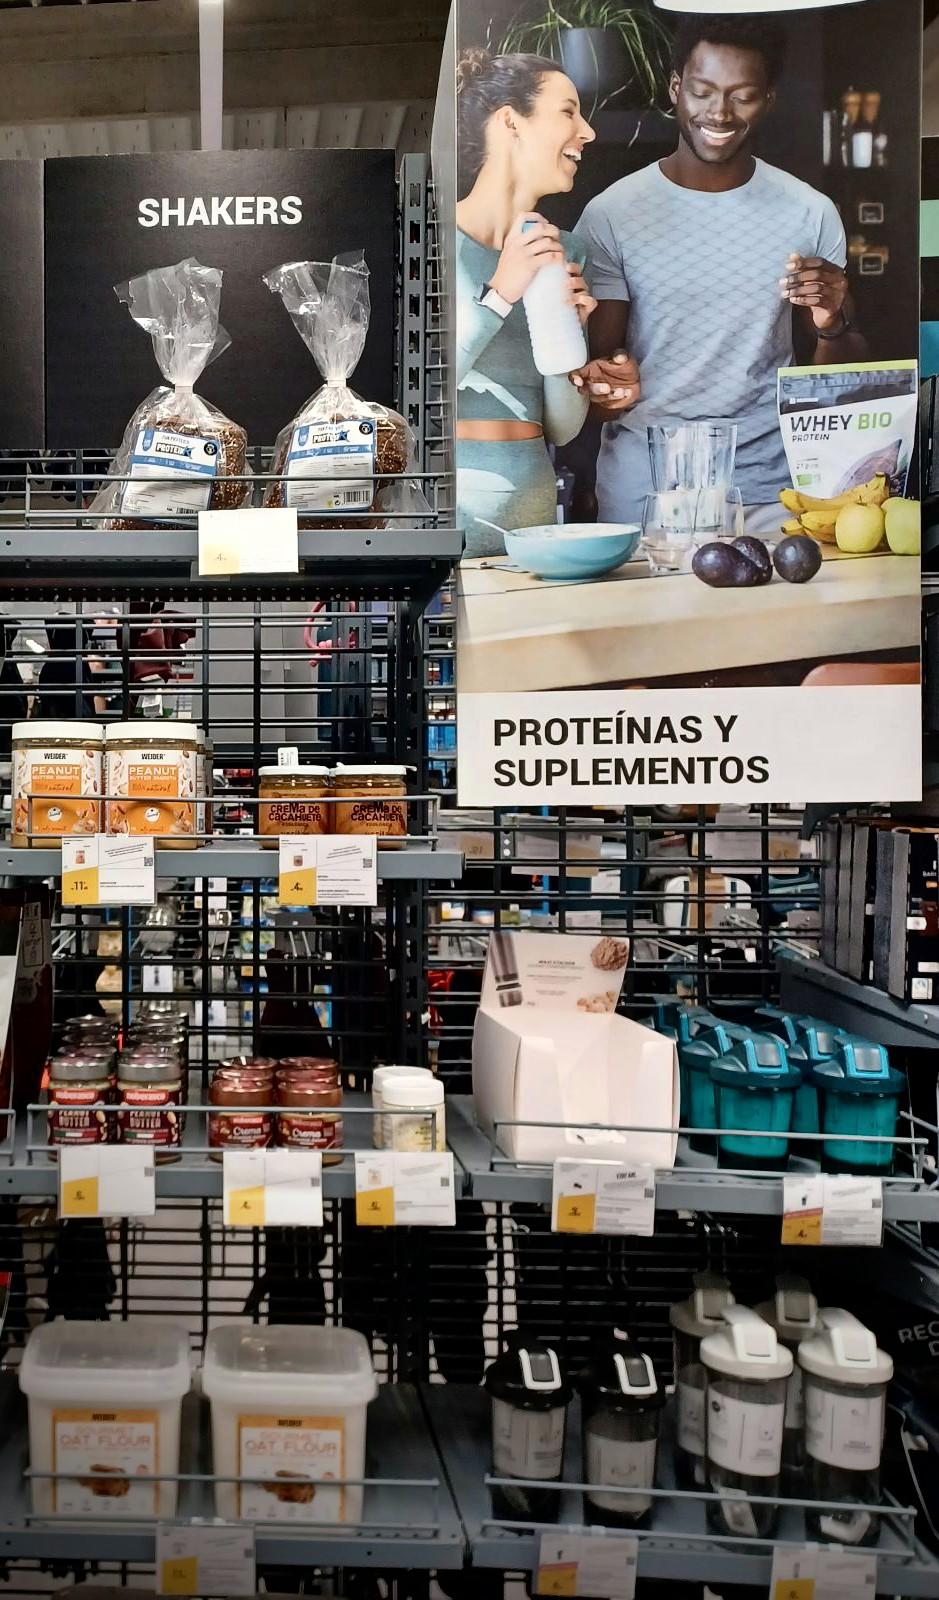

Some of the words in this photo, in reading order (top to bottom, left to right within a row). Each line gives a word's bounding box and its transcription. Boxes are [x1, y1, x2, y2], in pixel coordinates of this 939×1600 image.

[137, 195, 303, 228] SHAKERS
[790, 414, 853, 432] WHEY
[858, 411, 892, 430] BIO
[792, 433, 830, 443] PROTEIN
[493, 709, 703, 747] PROTEÍNAS
[713, 714, 739, 743] Y
[44, 752, 67, 760] WEIDER
[31, 766, 80, 775] PEANUT
[129, 766, 177, 776] PEANUT
[493, 755, 770, 787] SUPLEMENTOS
[60, 1435, 90, 1447] OAT
[97, 1436, 151, 1447] FLOUR
[245, 1440, 276, 1451] OAT
[284, 1441, 337, 1453] FLOUR
